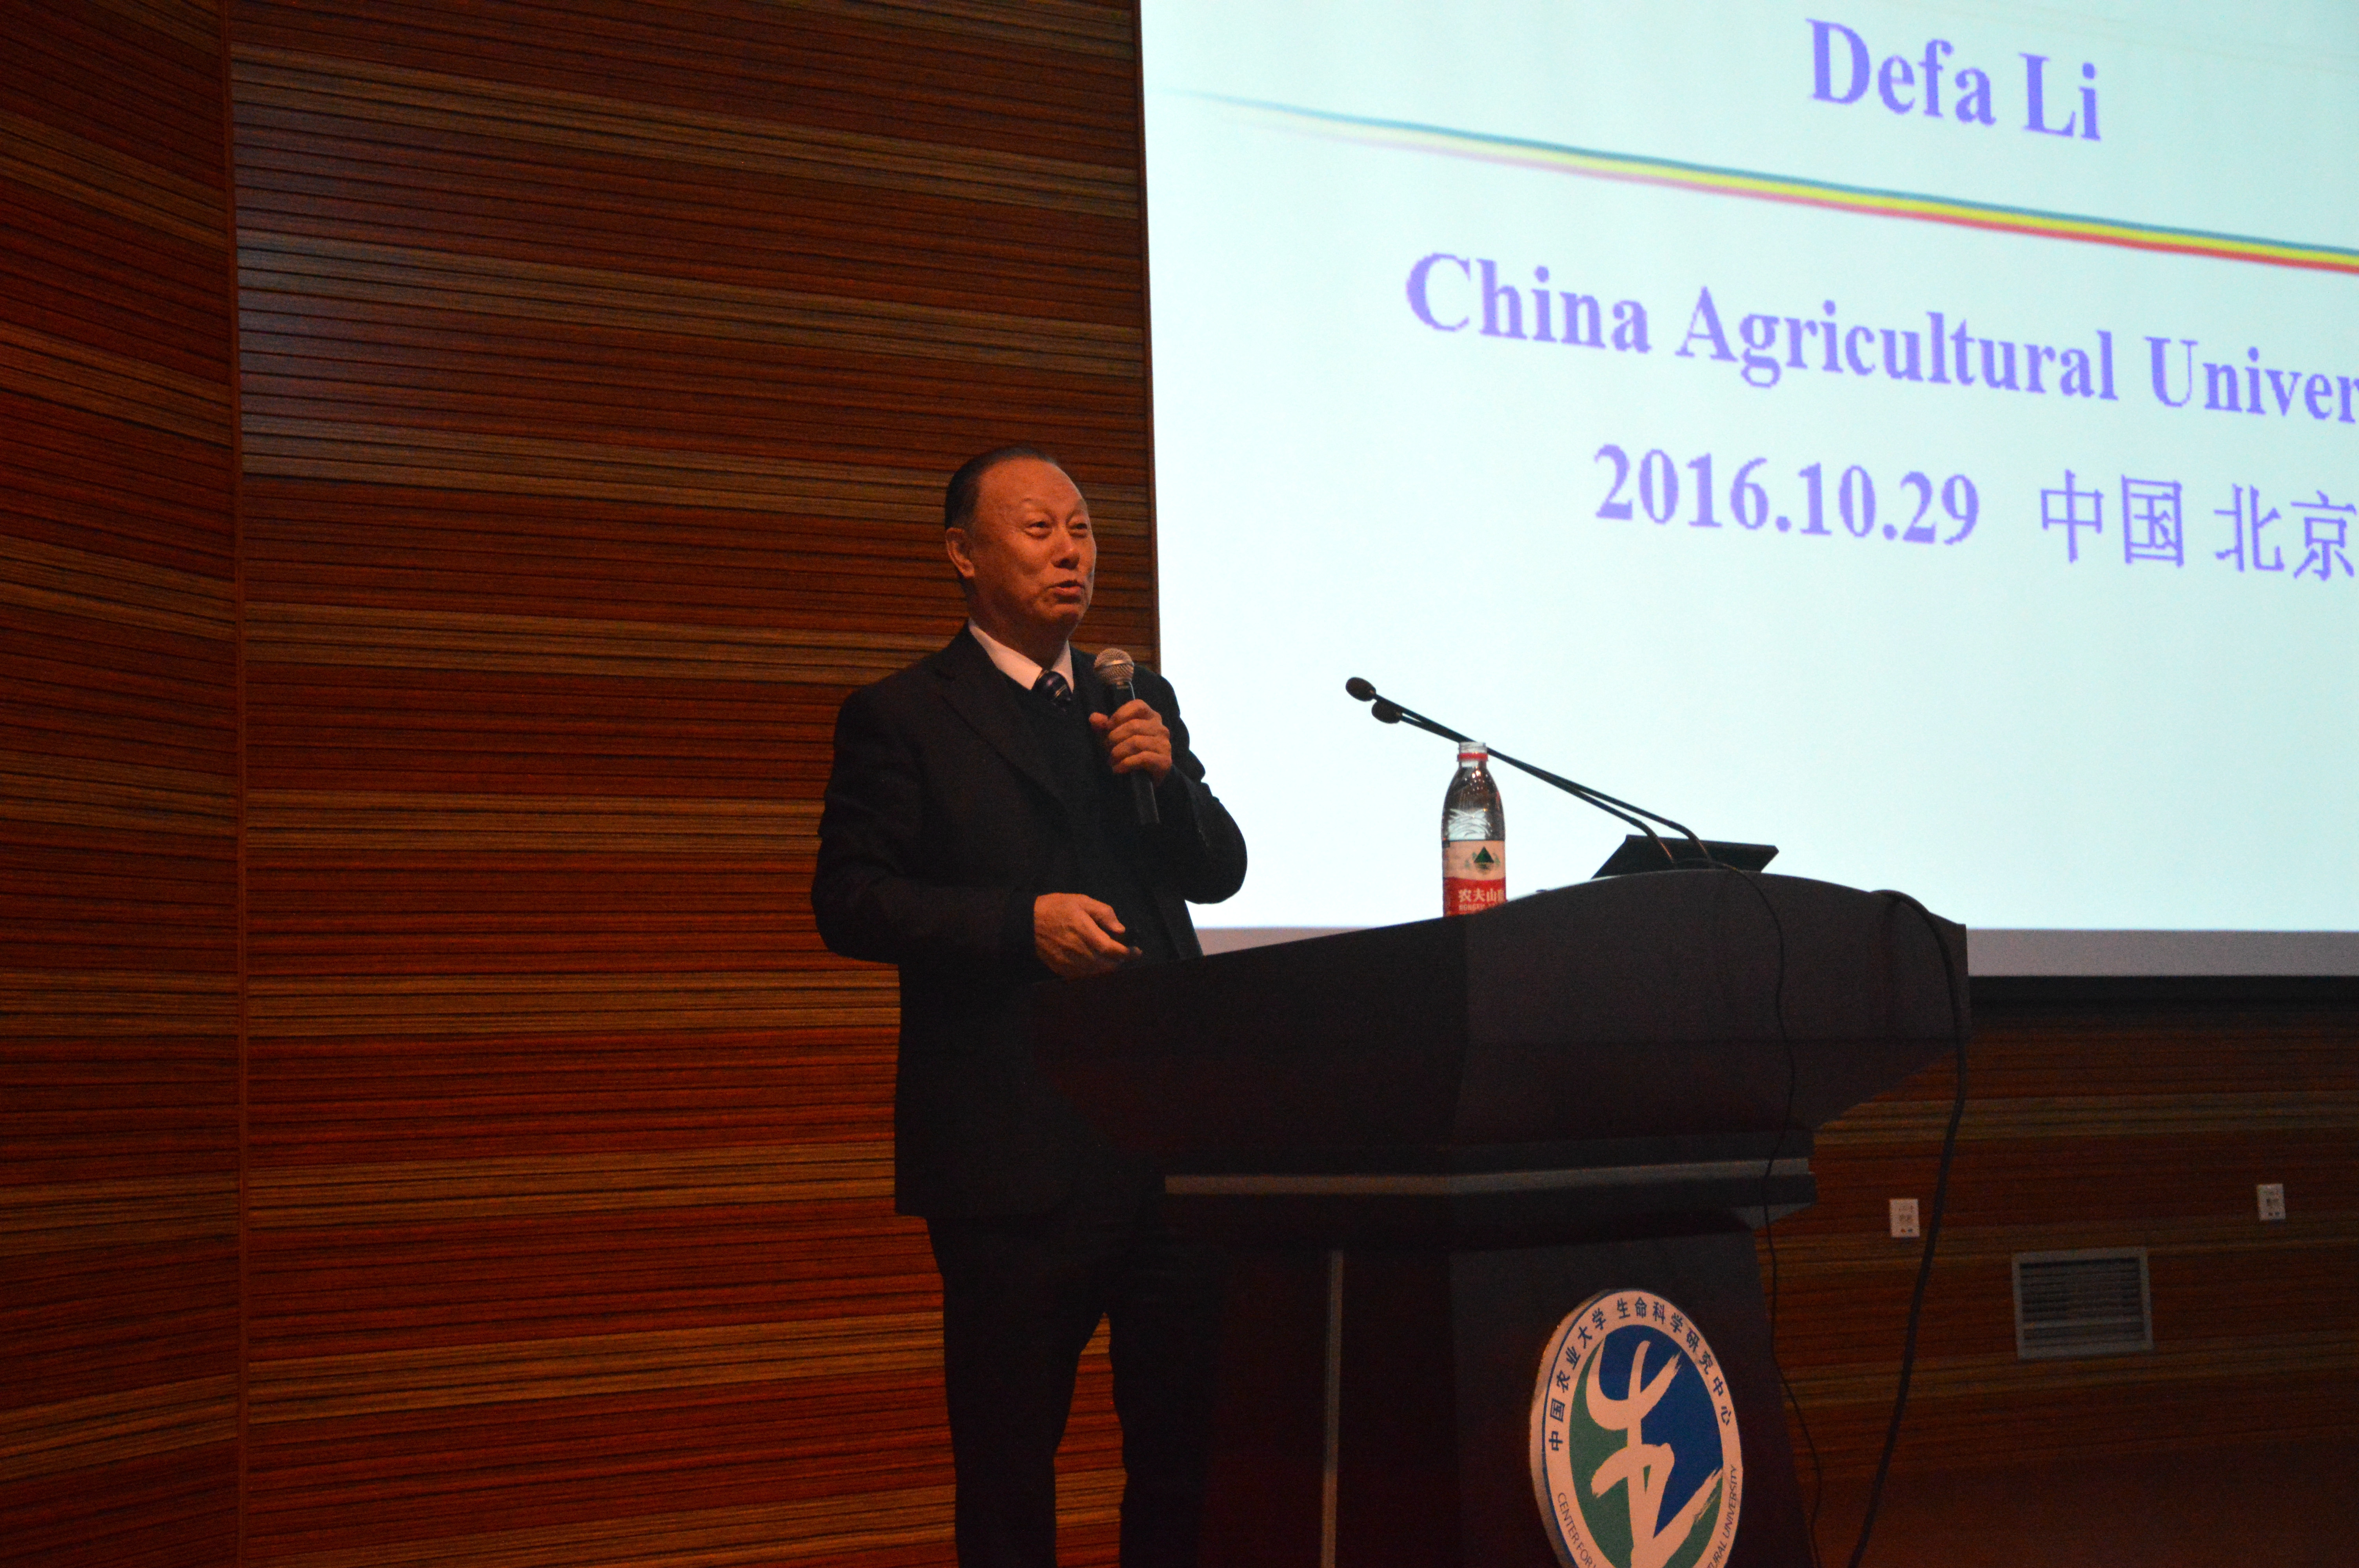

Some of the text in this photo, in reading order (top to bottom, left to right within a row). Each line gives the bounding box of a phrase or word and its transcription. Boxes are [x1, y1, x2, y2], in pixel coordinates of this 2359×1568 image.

[1806, 18, 2102, 142] Defa Li
[1407, 253, 2359, 424] China Agricultural Univer
[1597, 445, 2357, 581] 2016.10.29 中国 北京
[1558, 1492, 1593, 1567] CENTER FOR
[1722, 1464, 1737, 1539] UNIVERSITY
